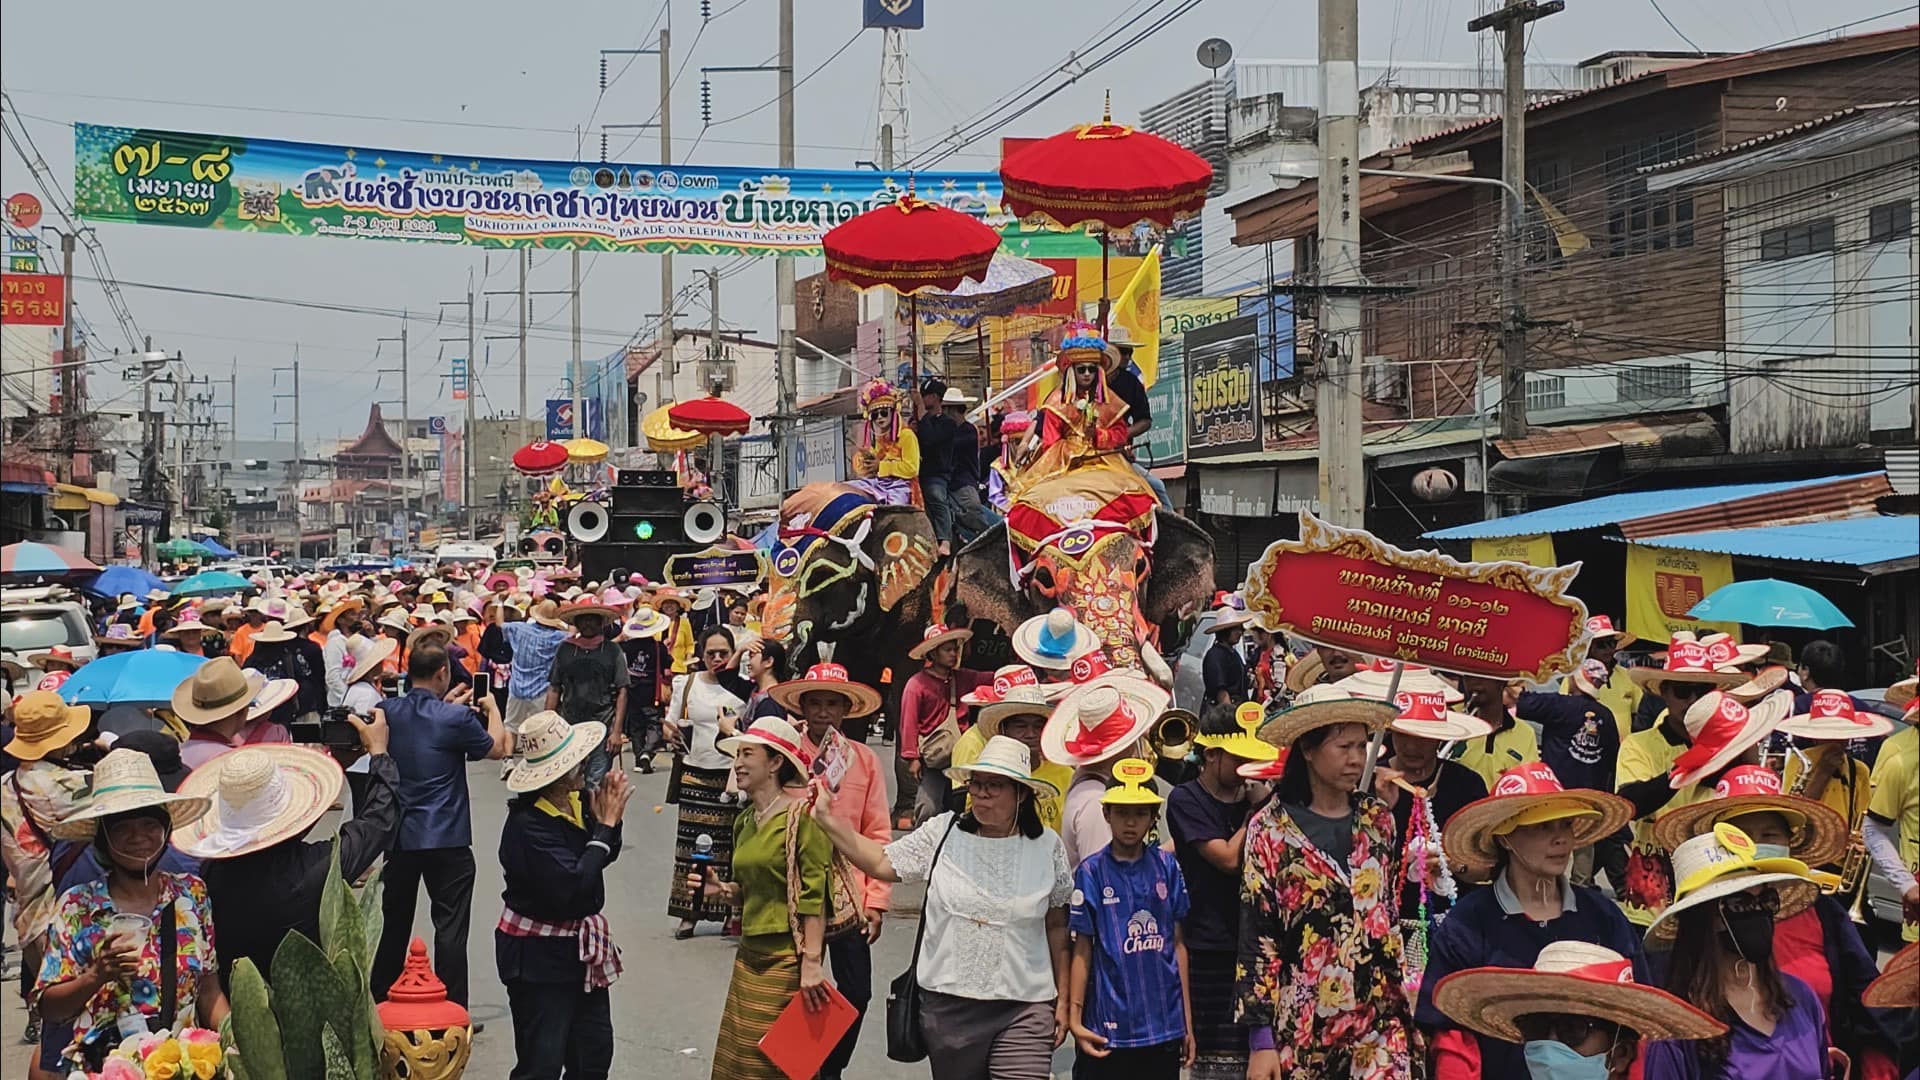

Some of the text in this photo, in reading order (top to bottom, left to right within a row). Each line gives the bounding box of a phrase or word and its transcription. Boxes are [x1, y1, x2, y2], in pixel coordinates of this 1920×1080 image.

[128, 177, 215, 199] เมษายน
[424, 170, 514, 188] งานประเพณี
[134, 195, 209, 215] ๒๕๖๗
[370, 217, 400, 232] April
[402, 220, 436, 231] 2024
[468, 217, 538, 230] SUKHOTHAI
[541, 221, 615, 232] ORDINATION
[619, 225, 664, 237] PARADE
[668, 225, 685, 234] ON
[689, 227, 750, 240] ELEPHANT
[753, 231, 782, 240] BACK
[1, 281, 46, 295] ทอง
[1338, 569, 1510, 616] ขบวนช้างที่ ๑๑-๑๒
